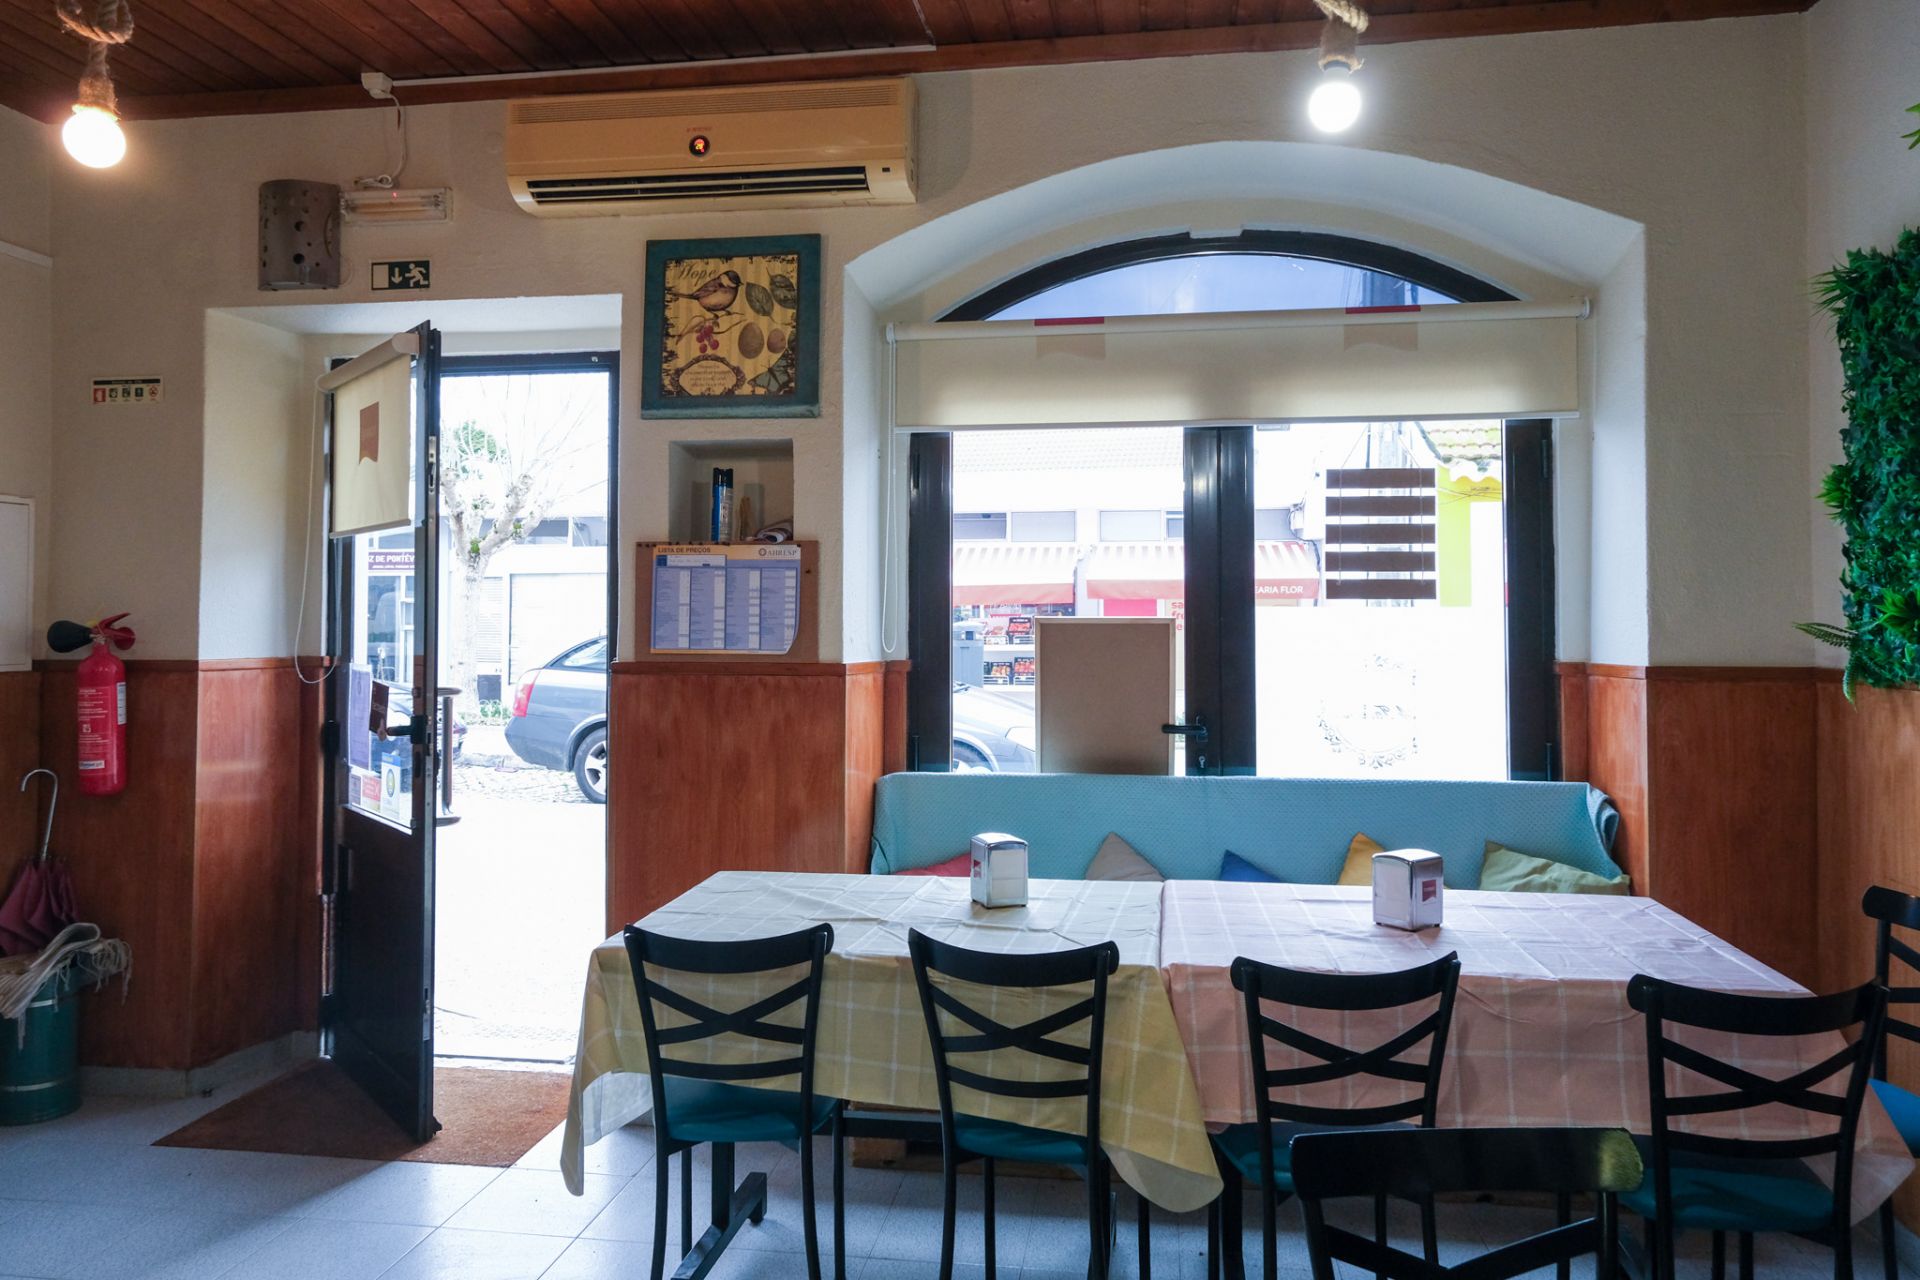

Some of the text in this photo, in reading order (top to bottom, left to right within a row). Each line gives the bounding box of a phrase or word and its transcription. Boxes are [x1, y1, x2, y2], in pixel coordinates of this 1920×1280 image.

[678, 263, 717, 287] Hope
[657, 546, 675, 554] LISTA
[685, 546, 711, 555] PREÇOS
[1280, 585, 1304, 594] FLOR
